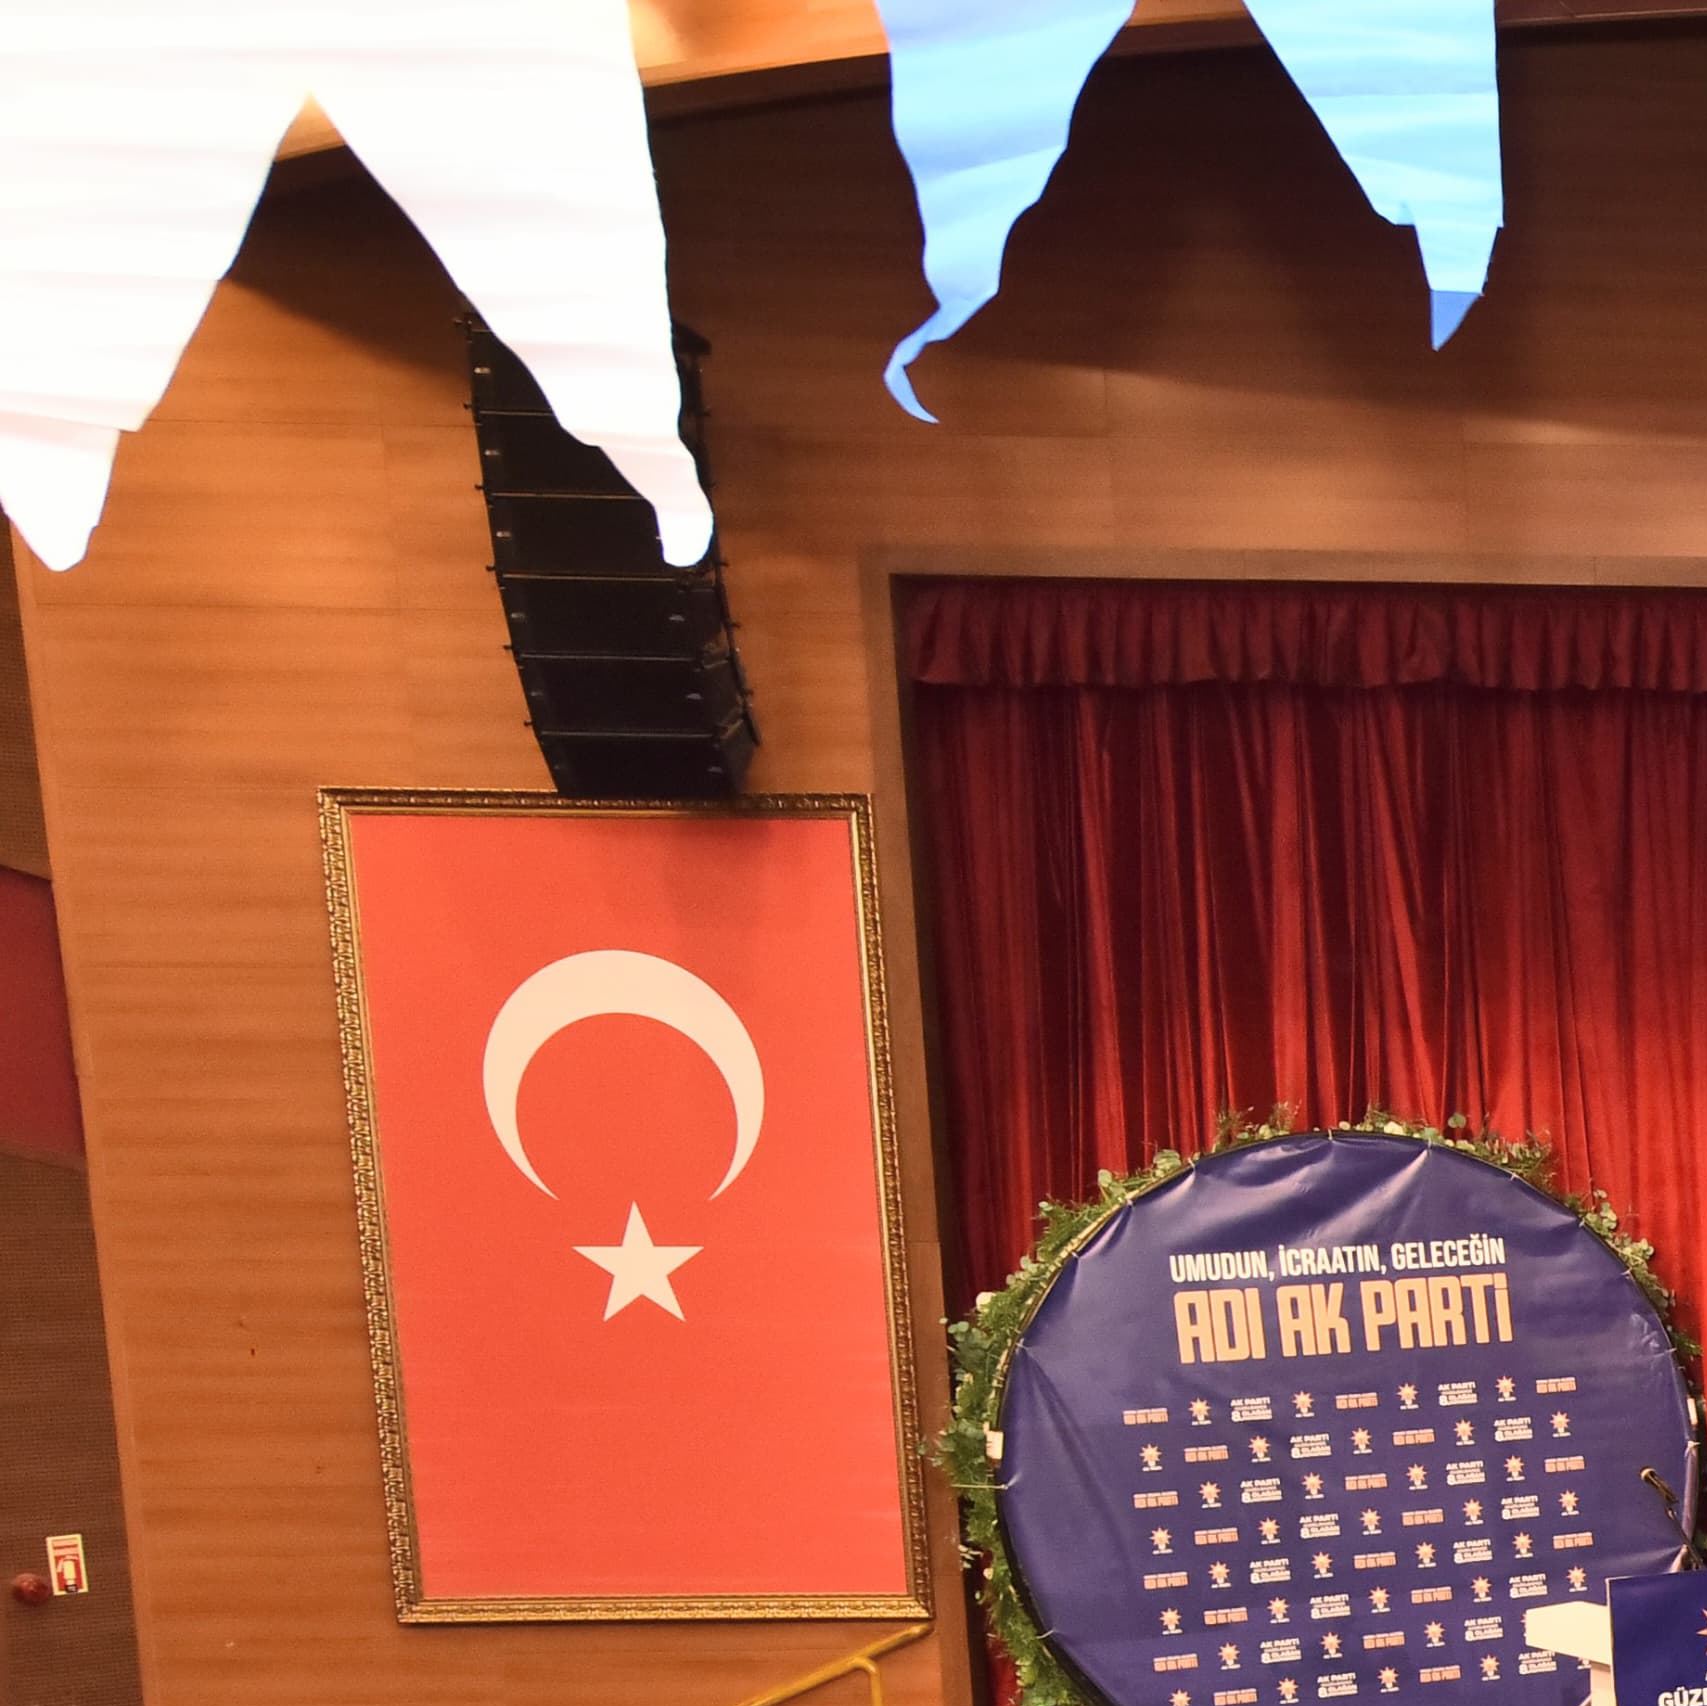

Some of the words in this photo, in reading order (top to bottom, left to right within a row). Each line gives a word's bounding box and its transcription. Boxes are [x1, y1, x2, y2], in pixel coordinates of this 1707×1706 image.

[1168, 1250, 1277, 1283] UMUDUN,
[1277, 1243, 1387, 1278] İCRAATIN,
[1390, 1232, 1507, 1271] GELECEĞİN
[1173, 1287, 1268, 1365] ADI
[1276, 1281, 1352, 1358] AK
